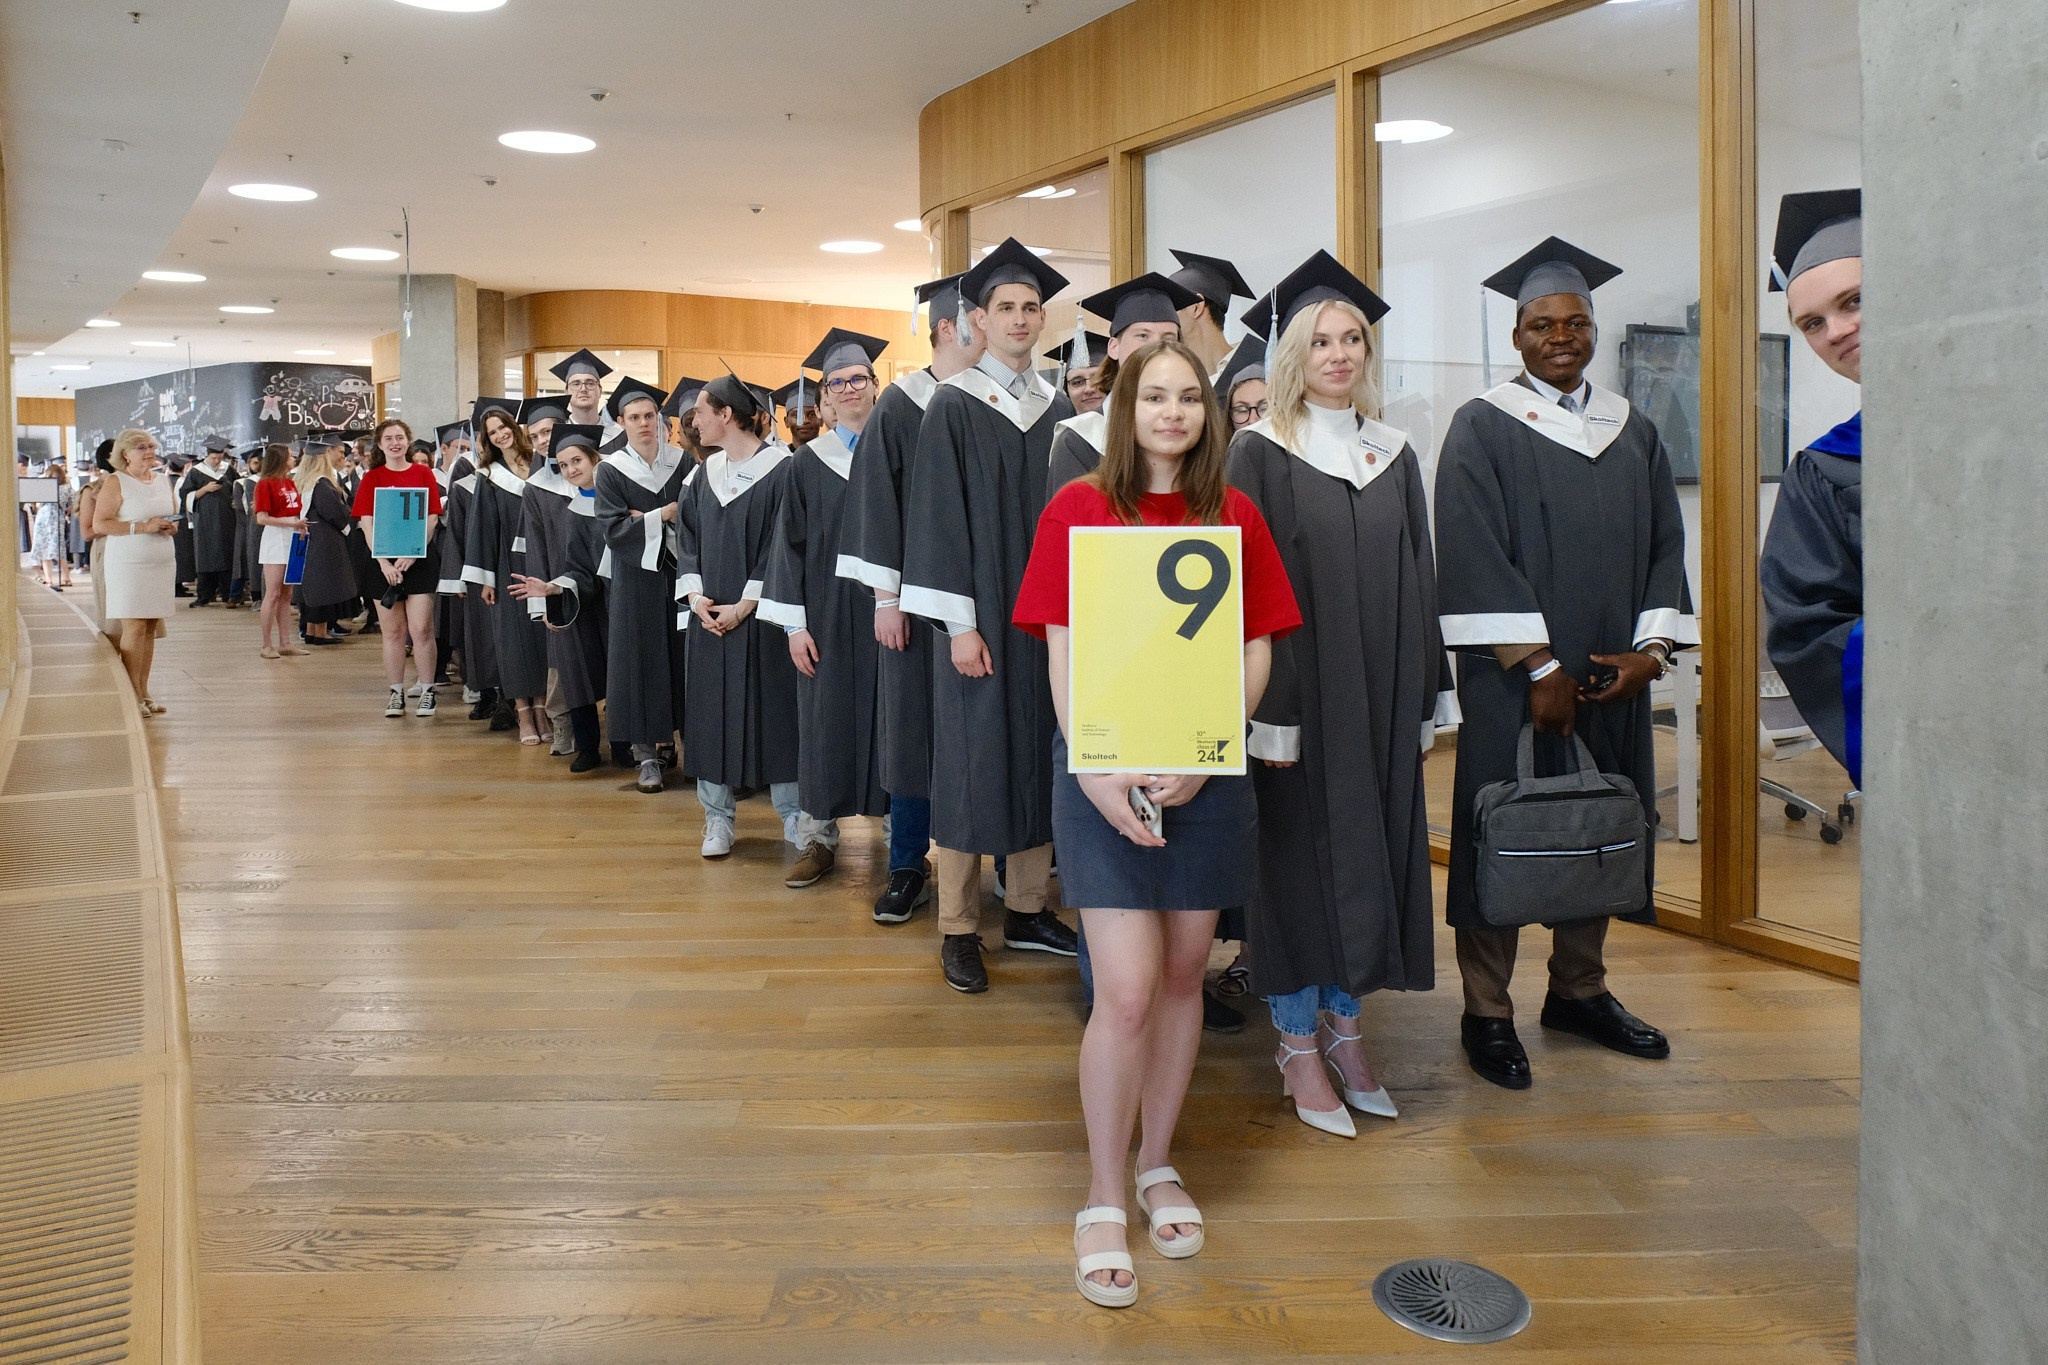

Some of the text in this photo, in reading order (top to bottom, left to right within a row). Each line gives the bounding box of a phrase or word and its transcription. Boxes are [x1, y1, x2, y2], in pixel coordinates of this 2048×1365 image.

[288, 402, 313, 425] Bb
[1589, 416, 1619, 424] Skoltech
[1361, 439, 1390, 455] Skoltech
[399, 491, 425, 520] 11
[1156, 538, 1231, 641] 9
[1081, 752, 1118, 760] Skoltech
[1197, 749, 1217, 763] 24
